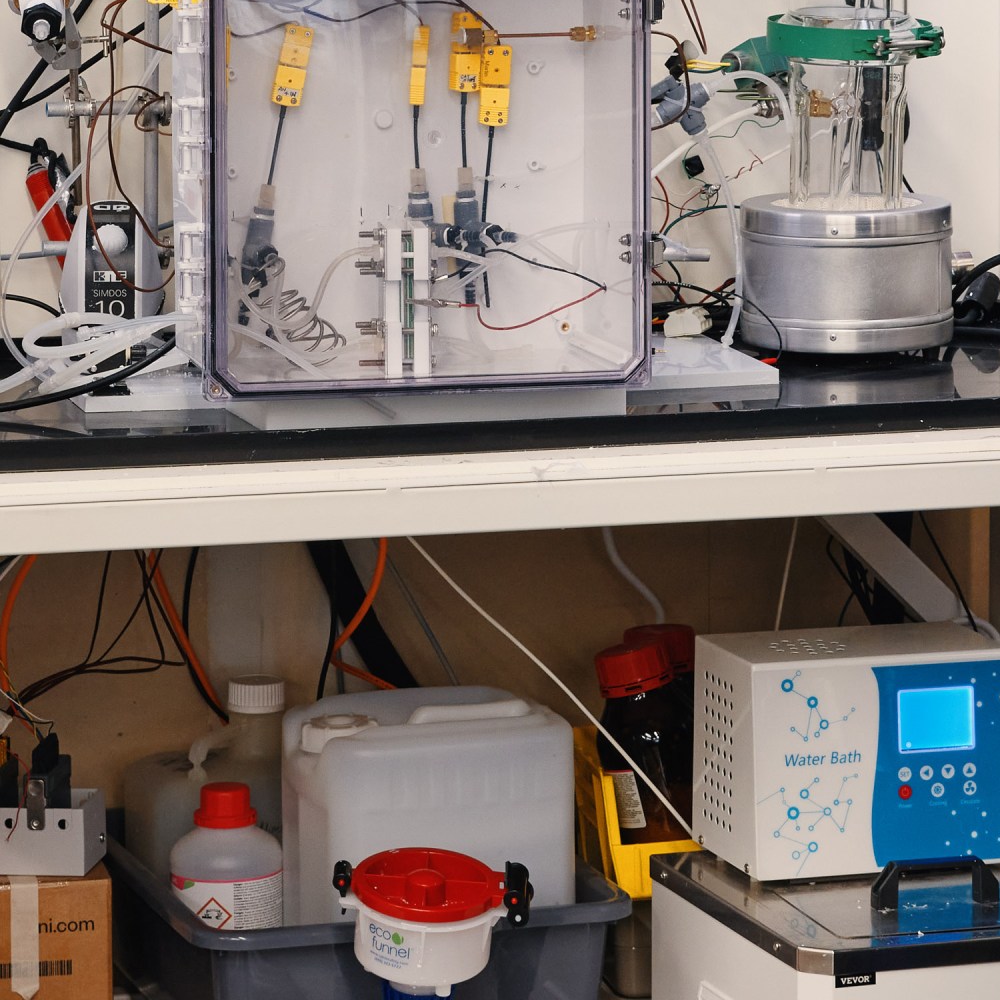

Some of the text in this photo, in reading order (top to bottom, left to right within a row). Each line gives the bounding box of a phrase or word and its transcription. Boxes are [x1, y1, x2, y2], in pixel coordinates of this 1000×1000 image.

[93, 289, 127, 297] SIMDOS
[95, 300, 124, 316] 10
[785, 750, 861, 767] Water Bath
[369, 923, 391, 940] eco
[372, 936, 410, 959] funnel
[841, 976, 870, 984] VEVOR
